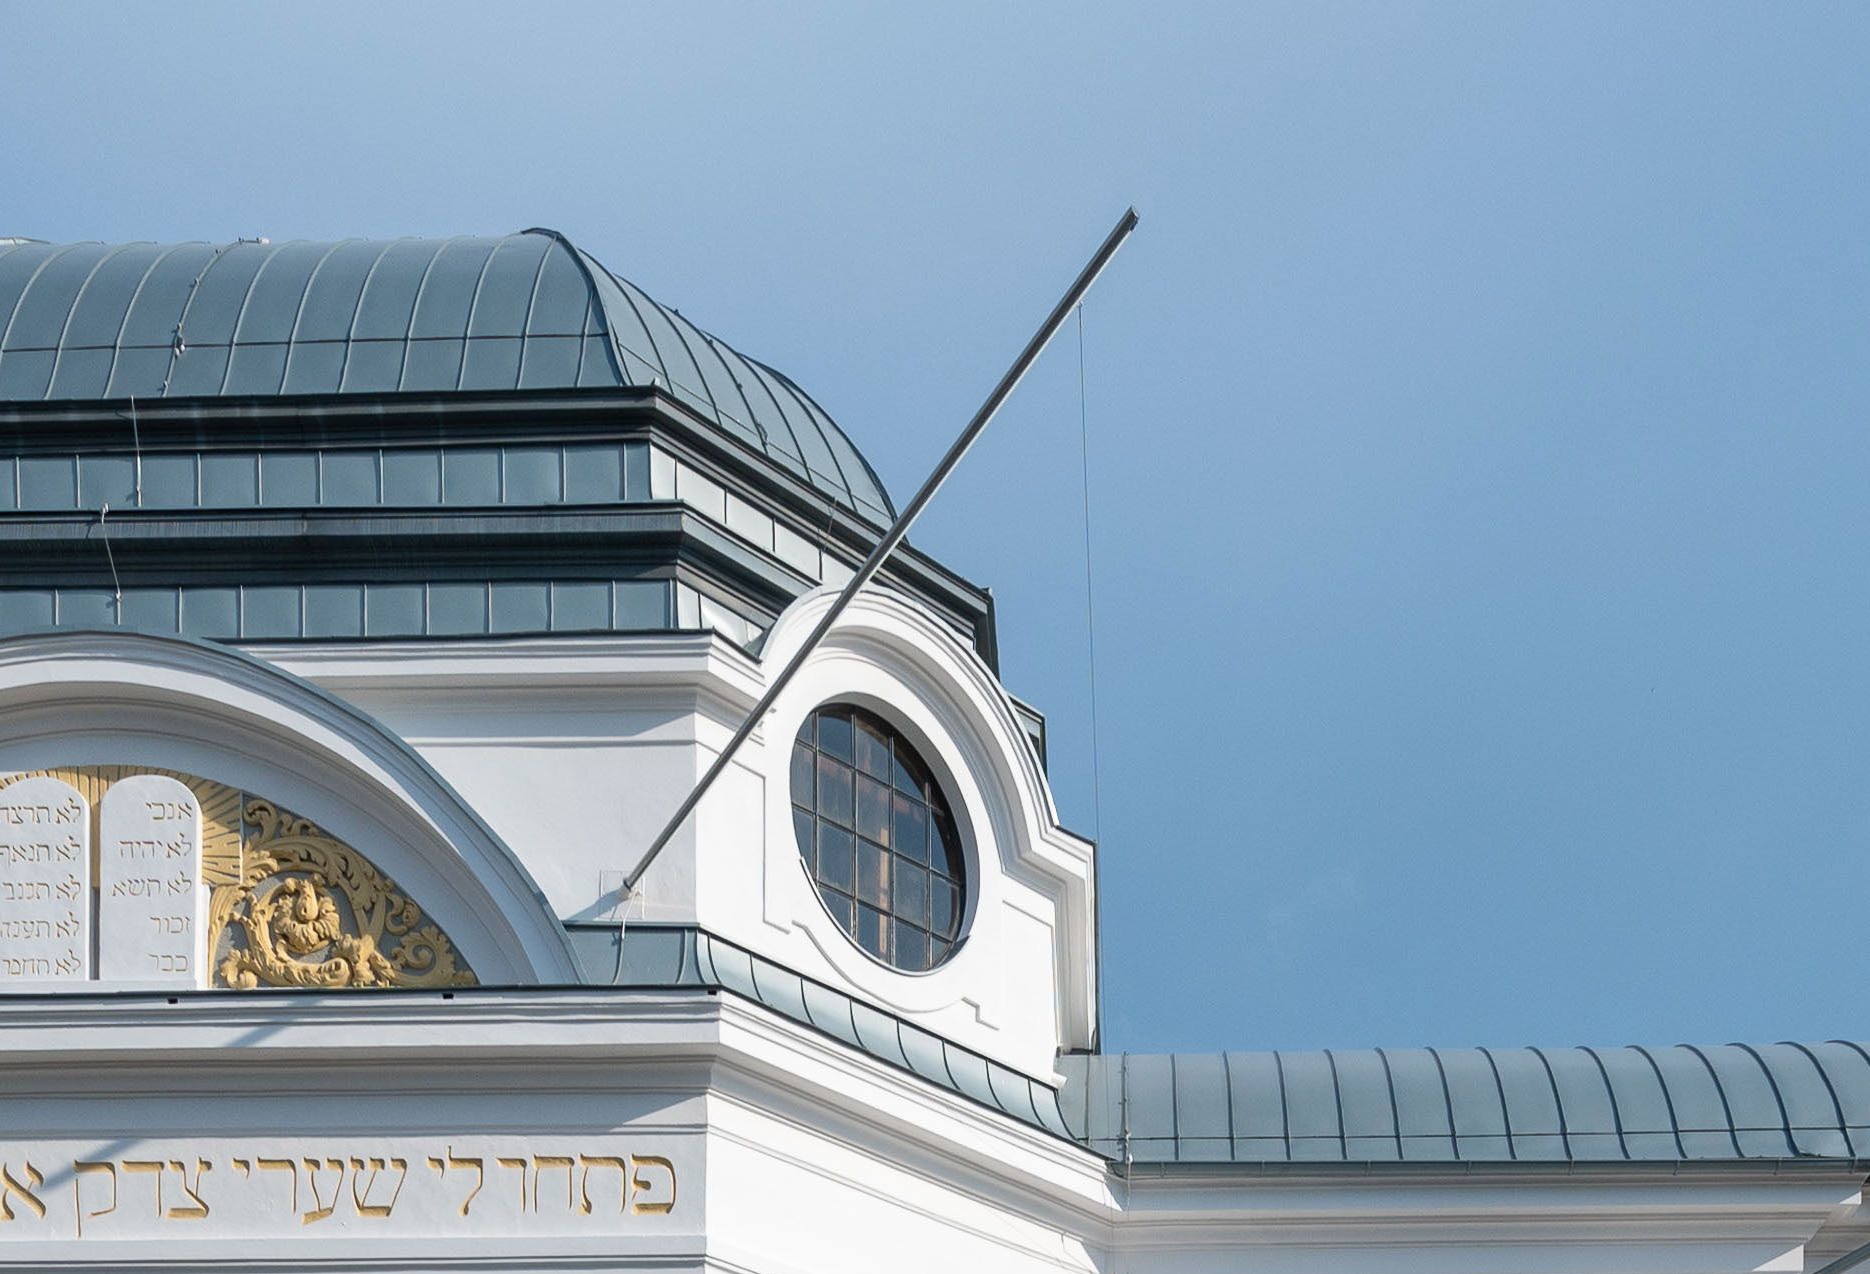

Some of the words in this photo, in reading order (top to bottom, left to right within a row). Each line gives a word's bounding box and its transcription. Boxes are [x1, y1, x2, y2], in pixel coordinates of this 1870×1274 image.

[55, 797, 81, 824] לא
[145, 802, 193, 820] אנכי
[55, 835, 81, 862] לא
[166, 832, 192, 858] לא
[55, 873, 81, 901] לא
[167, 870, 192, 897] לא
[55, 910, 80, 938] לא
[55, 948, 81, 975] לא
[232, 1156, 409, 1227] שערי
[426, 1145, 484, 1218] לי
[496, 1152, 678, 1218] פתחו
[72, 1157, 213, 1240] צדק
